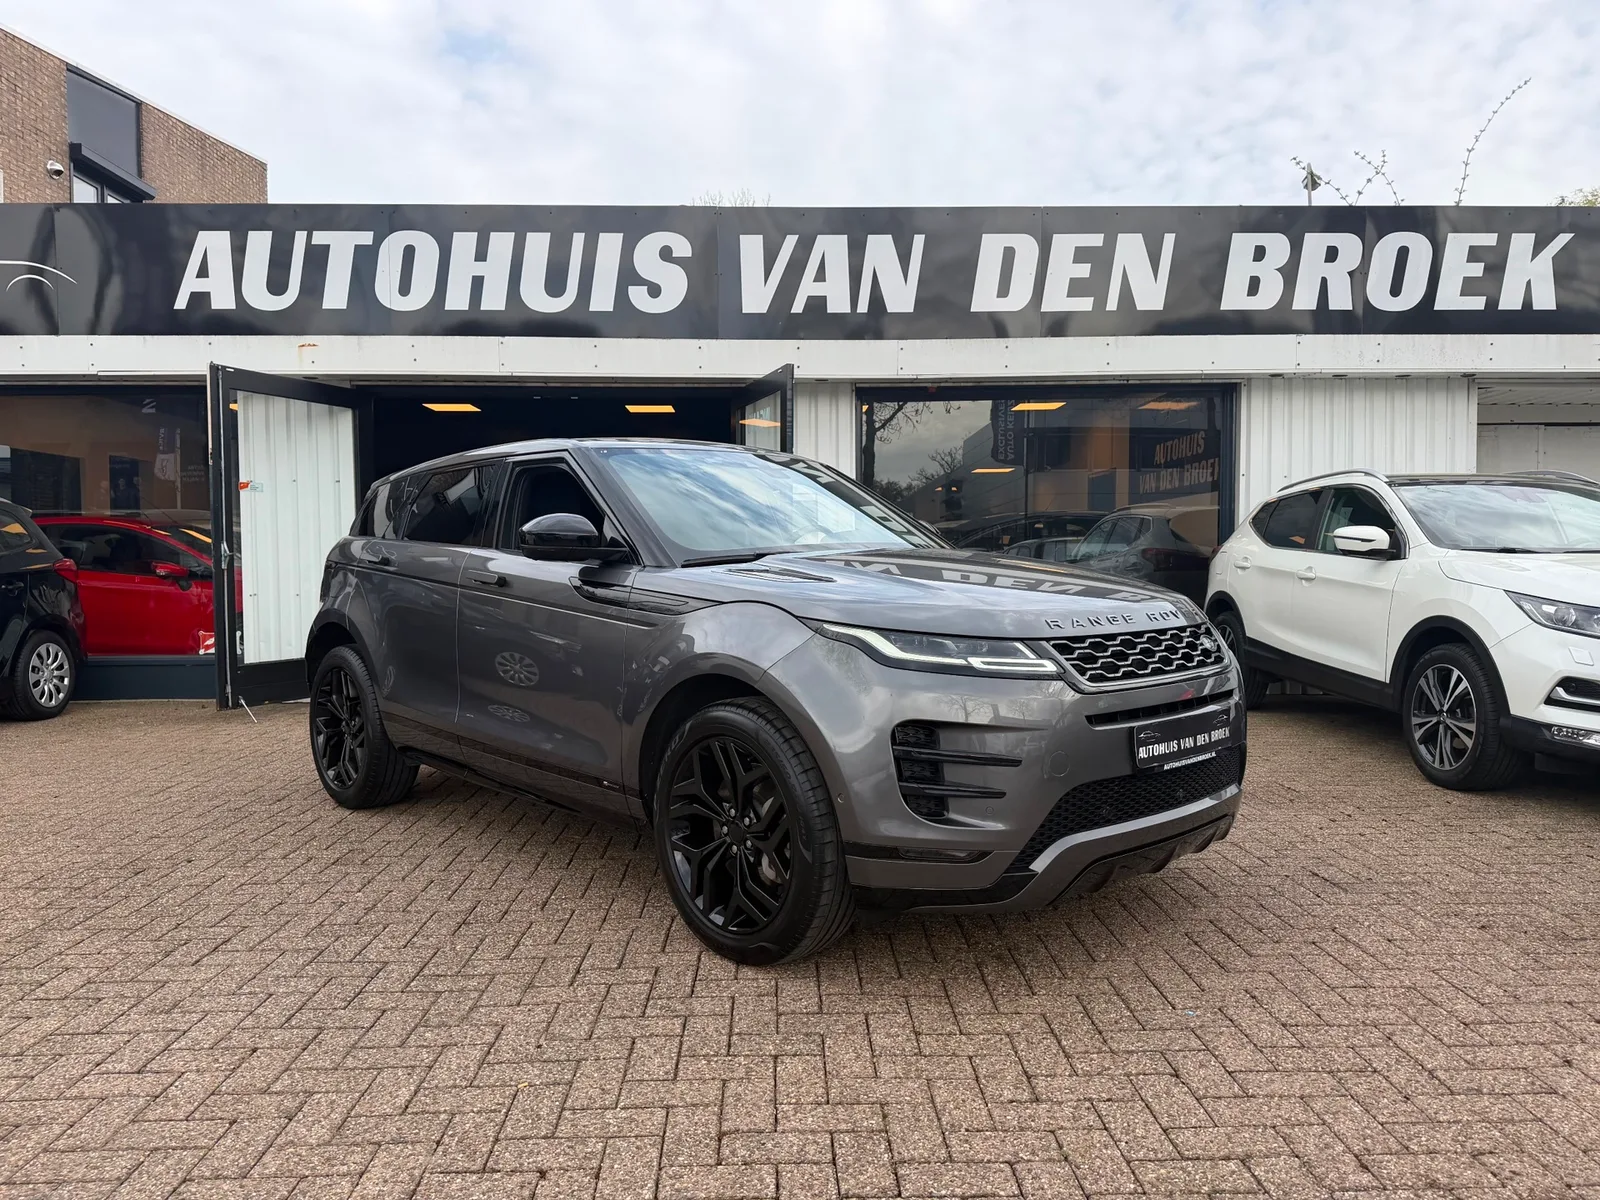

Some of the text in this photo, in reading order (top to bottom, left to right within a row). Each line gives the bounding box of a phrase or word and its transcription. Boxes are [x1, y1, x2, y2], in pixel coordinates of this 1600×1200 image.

[174, 229, 1575, 315] AUTOHUIS VAN DEN BROEK
[1153, 430, 1206, 466] AUTOHUIS
[1139, 472, 1157, 494] VAN
[1159, 466, 1180, 491] DEN
[1045, 613, 1136, 630] RANGE
[1138, 726, 1230, 759] AUTOHUIS VAN DEN BROEK
